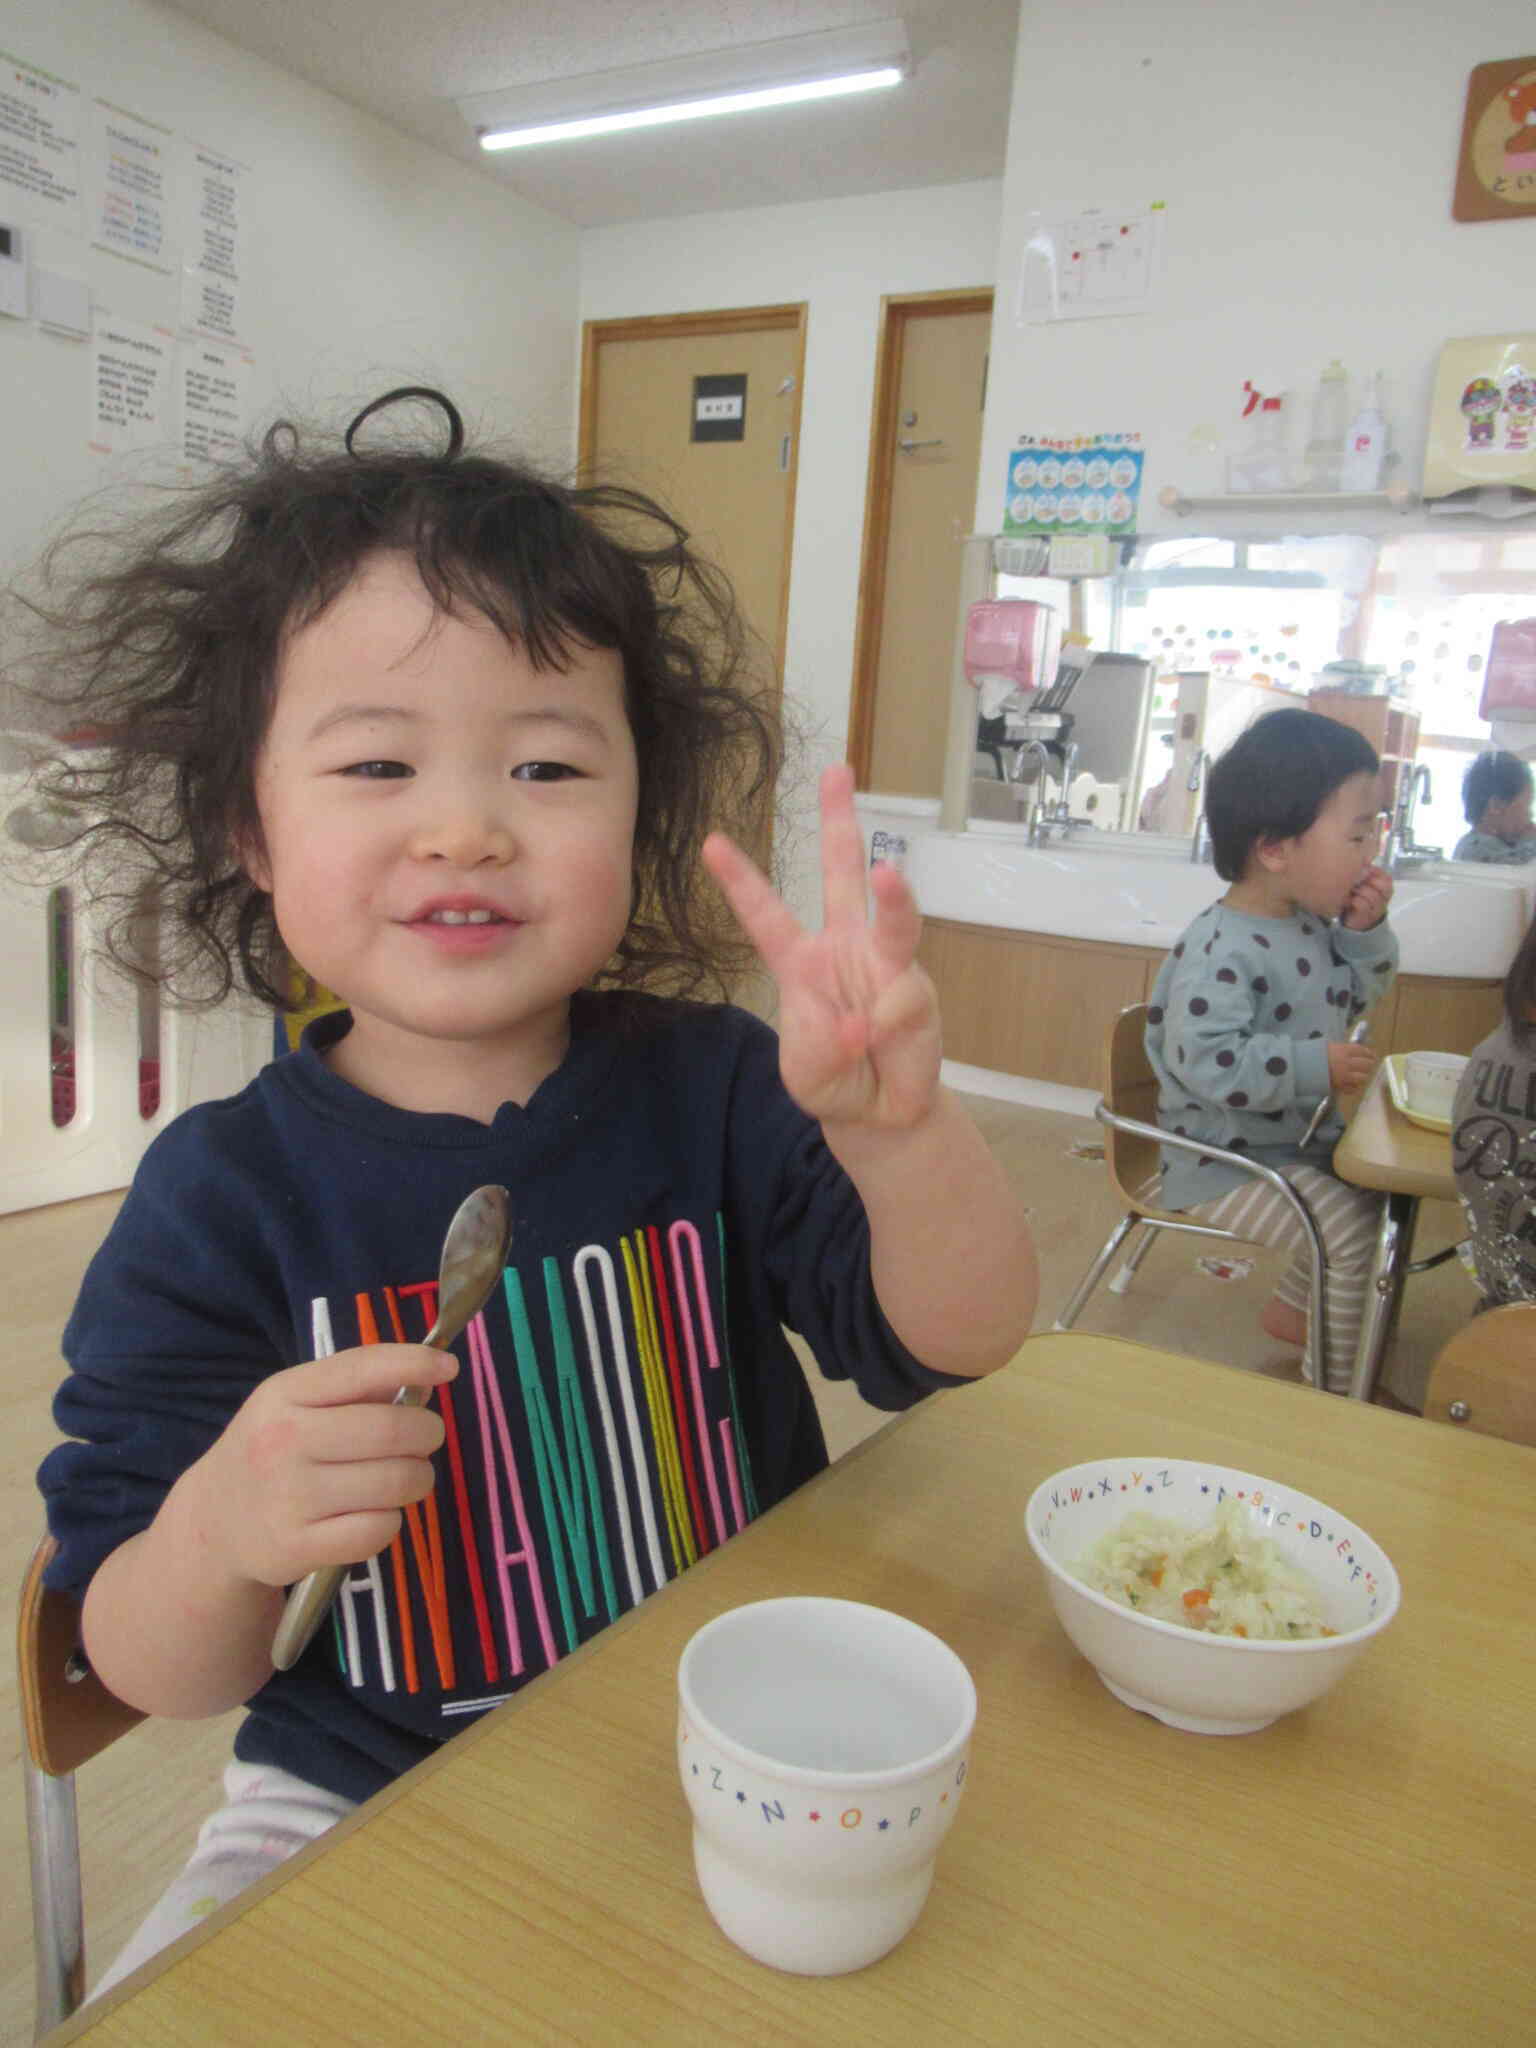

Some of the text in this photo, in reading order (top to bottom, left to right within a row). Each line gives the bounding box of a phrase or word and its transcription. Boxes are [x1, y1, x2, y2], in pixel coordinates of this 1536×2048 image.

[1070, 1487, 1083, 1503] W
[1097, 1477, 1112, 1497] X
[1131, 1471, 1143, 1488] Y
[1157, 1470, 1174, 1489] Z
[1276, 1511, 1291, 1526] C
[1310, 1520, 1322, 1538] D
[1336, 1538, 1352, 1558] E
[1350, 1565, 1362, 1583] F
[710, 1766, 724, 1792] Z
[760, 1799, 785, 1824] N
[840, 1807, 862, 1829] O
[907, 1806, 921, 1828] P
